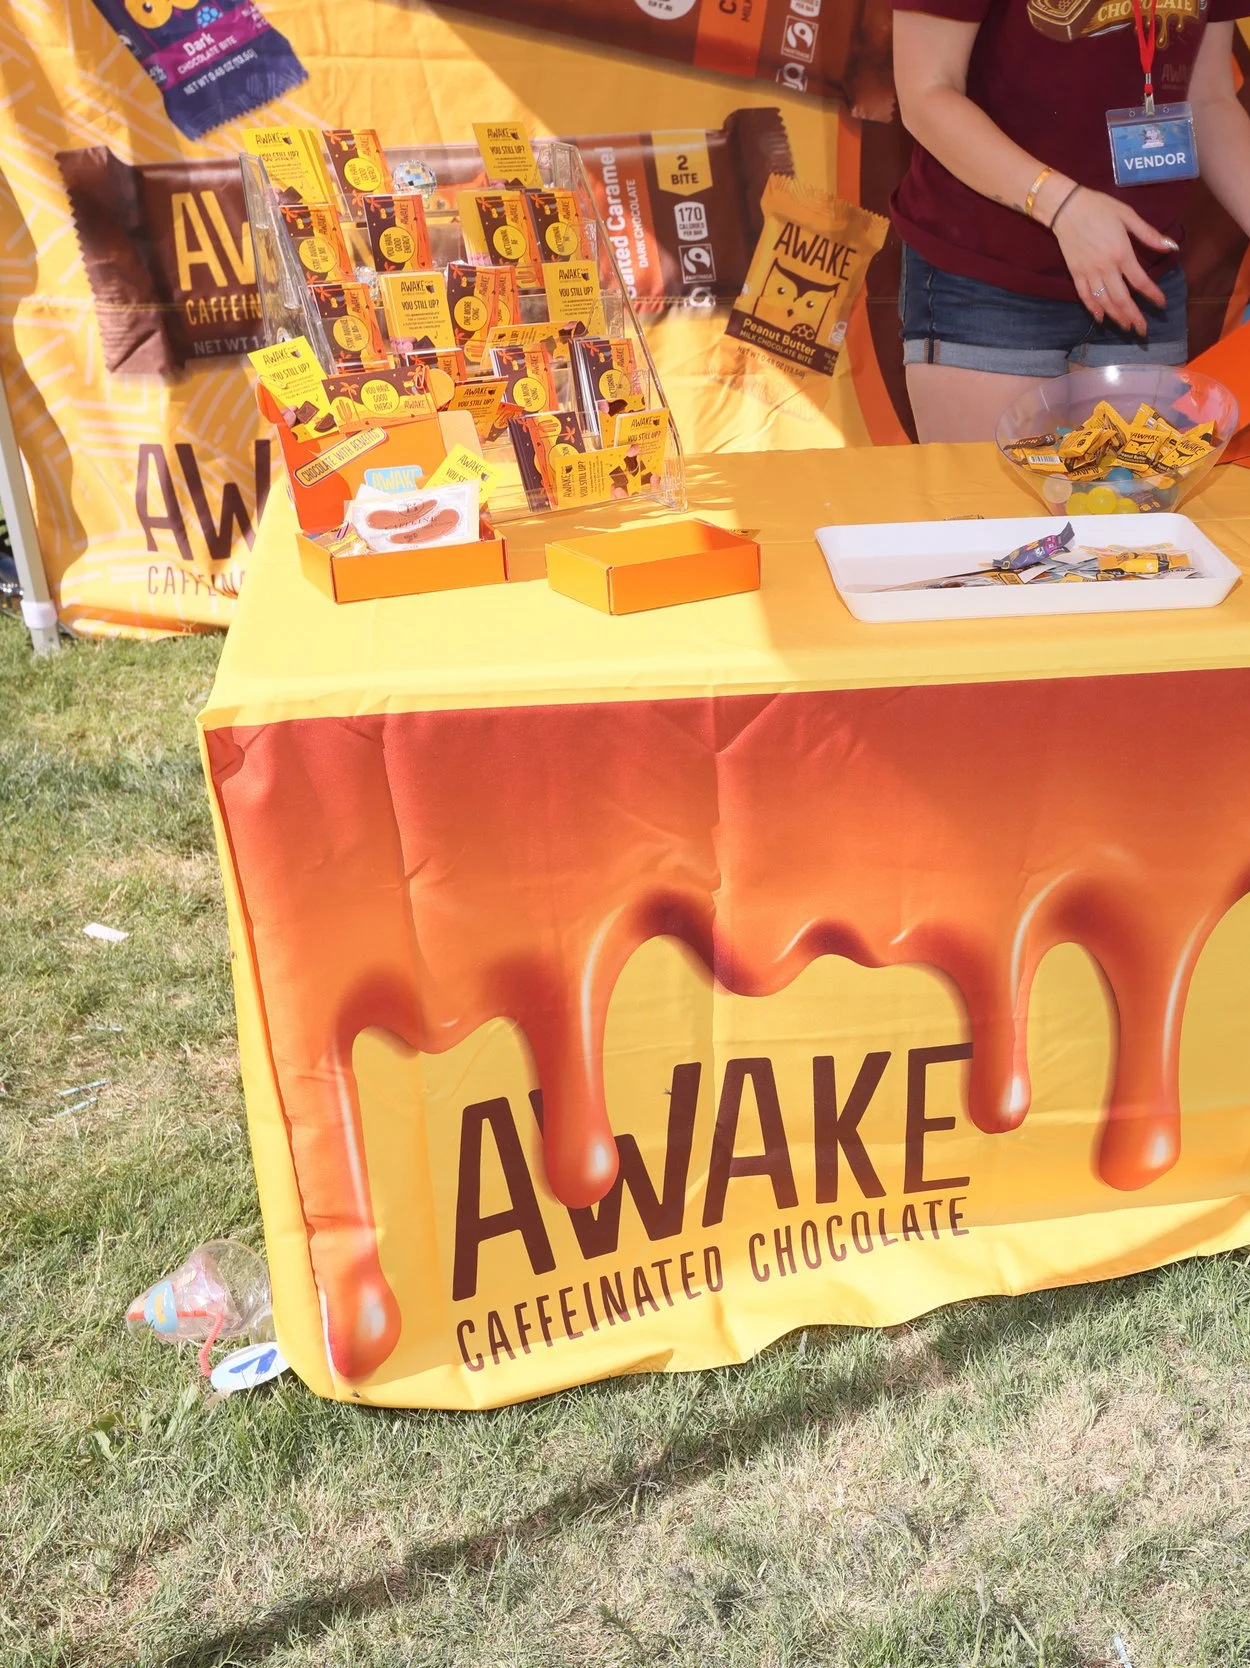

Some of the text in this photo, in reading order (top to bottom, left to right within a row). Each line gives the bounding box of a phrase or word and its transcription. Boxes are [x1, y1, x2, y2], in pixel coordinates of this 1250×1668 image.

[1097, 0, 1193, 21] CHOOLATE
[182, 32, 215, 57] Dark
[177, 47, 220, 75] CHOCOLATE
[218, 35, 238, 51] BITE
[255, 132, 282, 145] AWAKE
[487, 128, 511, 138] AWAKE
[489, 144, 525, 155] YOU STILL UP?
[677, 155, 689, 171] 2
[1124, 152, 1186, 171] VENDOR
[670, 173, 699, 186] BITE
[595, 147, 626, 232] Caramel
[400, 202, 409, 225] AWAKE
[678, 206, 703, 222] 170
[626, 178, 649, 269] DARK CHOCOLATE
[393, 238, 402, 252] GOOD
[401, 235, 411, 254] ENERGY
[773, 221, 857, 282] AWAKE
[558, 268, 582, 281] AWAKE
[400, 279, 426, 292] AWAKE
[479, 275, 490, 297] AWAKE
[559, 286, 594, 297] YOU STILL UP?
[185, 293, 263, 327] CAFFEIN
[401, 300, 440, 310] YOU STILL UP?
[463, 300, 472, 314] MORE
[472, 307, 480, 321] SONG
[742, 318, 817, 357] Peanut Butter
[194, 337, 248, 355] NET WT
[740, 329, 757, 341] MILK
[757, 336, 797, 357] CHOCOLATE
[796, 353, 813, 365] BITE
[263, 347, 290, 366] AWAKE
[269, 363, 311, 382] YOU STILL UP?
[366, 384, 390, 394] YOU HAVE
[463, 387, 488, 396] AWAKE
[372, 394, 388, 403] GOOD
[404, 400, 425, 409] AWAKE
[483, 398, 494, 406] UP?
[373, 402, 394, 412] ENERGY
[631, 416, 653, 428] AWAKE
[628, 430, 661, 443] YOU STILL UP?
[301, 428, 381, 482] CHOCOLATE WITH BENEFITS
[458, 454, 482, 475] AWAKE
[446, 467, 457, 480] YOU
[579, 471, 588, 486] STILL
[563, 472, 573, 497] AWAKE
[580, 486, 588, 497] YOU
[452, 1042, 973, 1302] AWAKE
[457, 1197, 970, 1374] CAFFEINATED CHOCOLATE
